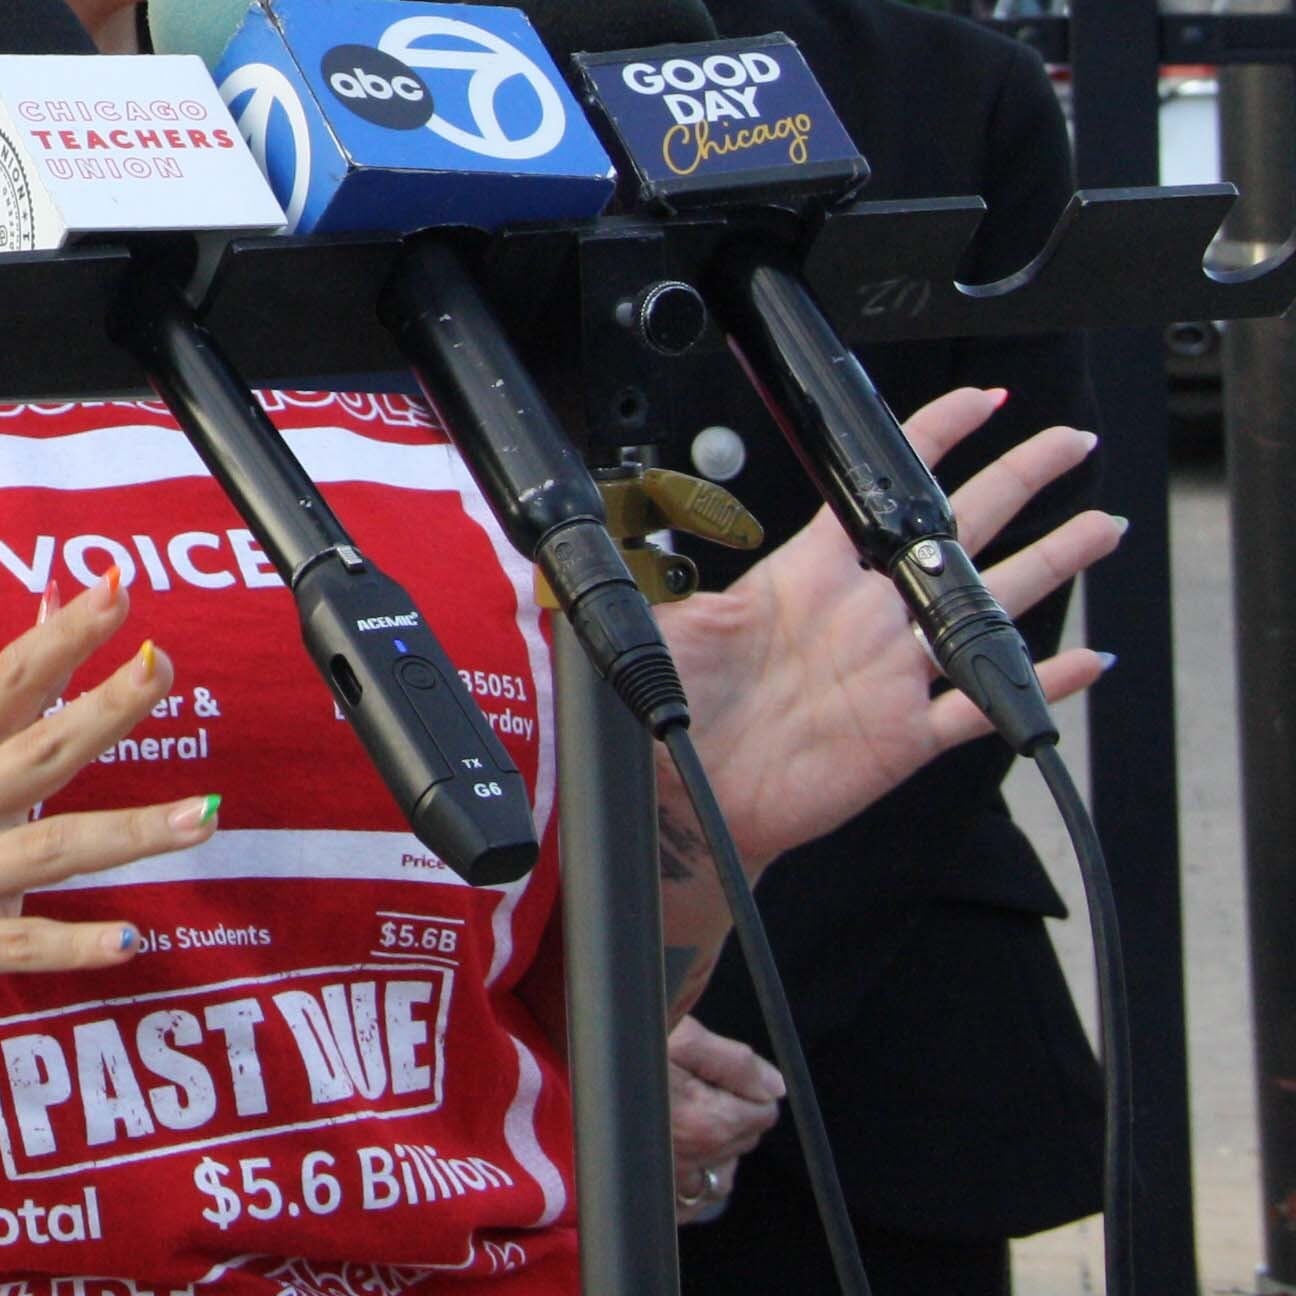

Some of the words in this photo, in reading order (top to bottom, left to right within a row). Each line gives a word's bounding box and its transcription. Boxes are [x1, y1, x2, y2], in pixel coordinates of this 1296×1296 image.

[330, 67, 424, 102] abc
[622, 51, 781, 96] GOOD
[17, 100, 208, 122] CHICAGO
[663, 85, 761, 124] DAY
[30, 129, 235, 150] TEACHERS
[662, 113, 812, 176] Chicago
[45, 157, 184, 179] UNION
[192, 687, 221, 717] &
[90, 728, 208, 764] eneral
[462, 758, 483, 769] TX
[473, 782, 503, 797] G6
[177, 923, 272, 949] Students
[380, 921, 457, 953] $5.6B
[1, 998, 269, 1157] PAST
[272, 981, 434, 1105] DUE
[194, 1150, 341, 1230] $5.6
[360, 1144, 513, 1210] Billion
